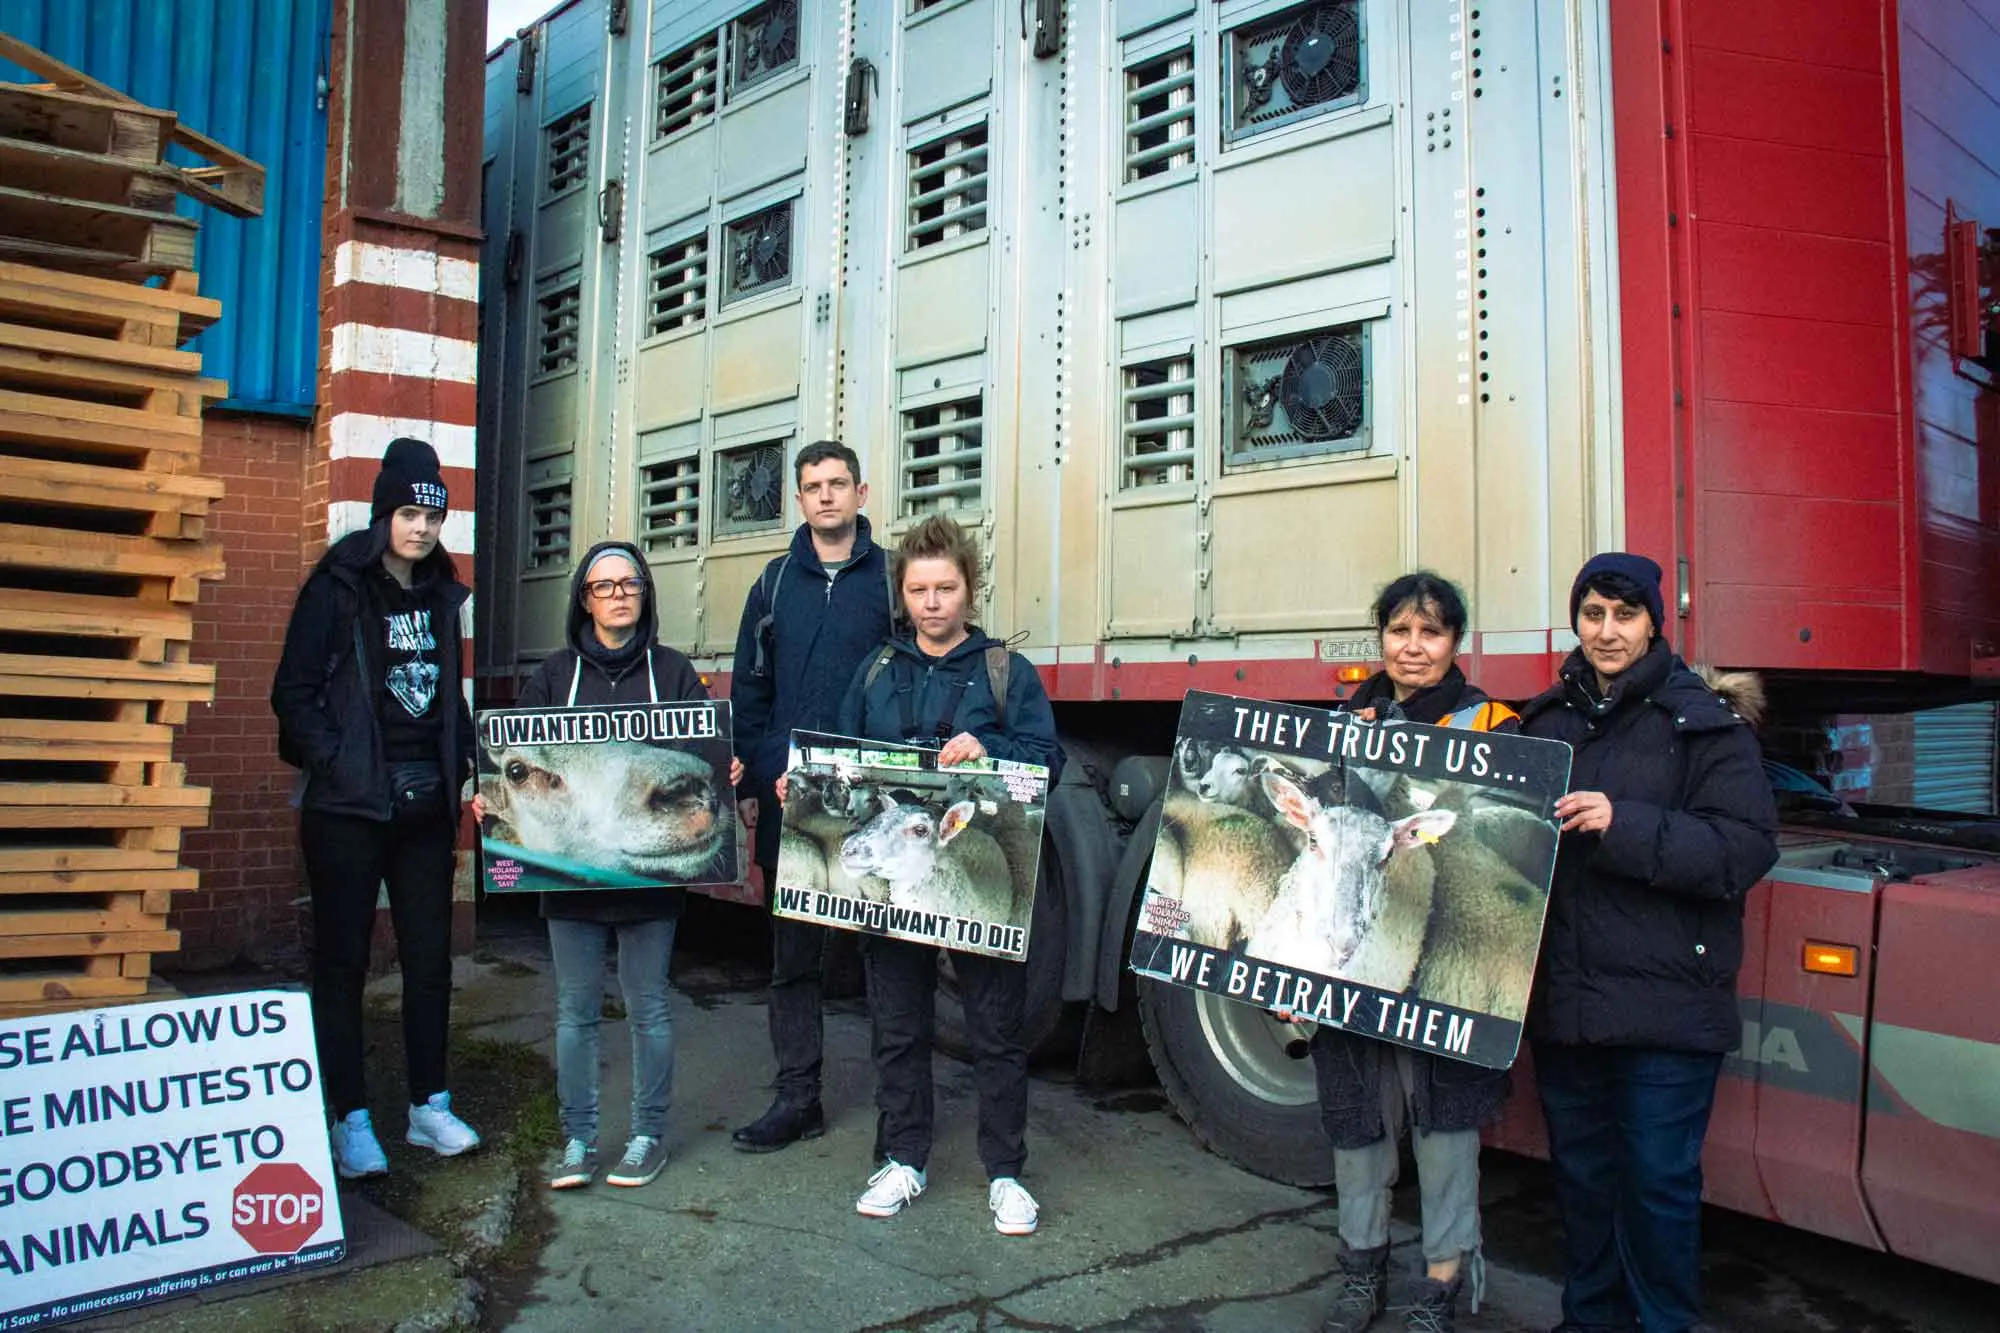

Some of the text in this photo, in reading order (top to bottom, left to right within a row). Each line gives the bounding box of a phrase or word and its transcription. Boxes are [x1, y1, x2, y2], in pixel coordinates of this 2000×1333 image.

[411, 482, 447, 498] VEGAN
[415, 494, 446, 508] TRIBE
[490, 707, 716, 746] I WANTED TO LIVE!
[1233, 707, 1527, 783] THEY TRUST US...
[778, 887, 1024, 954] WE DIDN'T WANT TO DIE
[1145, 903, 1191, 923] MIDLANDS
[1147, 914, 1183, 930] ANIMAL
[1157, 896, 1182, 910] WEST
[1152, 925, 1176, 938] SAVE
[1170, 945, 1475, 1056] WE BETRAY THEM
[60, 1007, 222, 1060] ALLOW
[230, 1000, 287, 1038] US
[1725, 1019, 1809, 1073] IA
[0, 1058, 312, 1137] E MINUTES TO
[222, 1125, 284, 1164] TO
[234, 1193, 322, 1225] STOP
[0, 1201, 211, 1276] ANIMALS
[10, 1312, 41, 1329] Save
[52, 1305, 68, 1319] No
[71, 1288, 145, 1313] unnecessary
[147, 1276, 197, 1297] suffering
[200, 1273, 213, 1285] is,
[215, 1270, 228, 1281] or
[229, 1267, 248, 1279] can
[250, 1261, 273, 1274] ever
[274, 1257, 288, 1269] be
